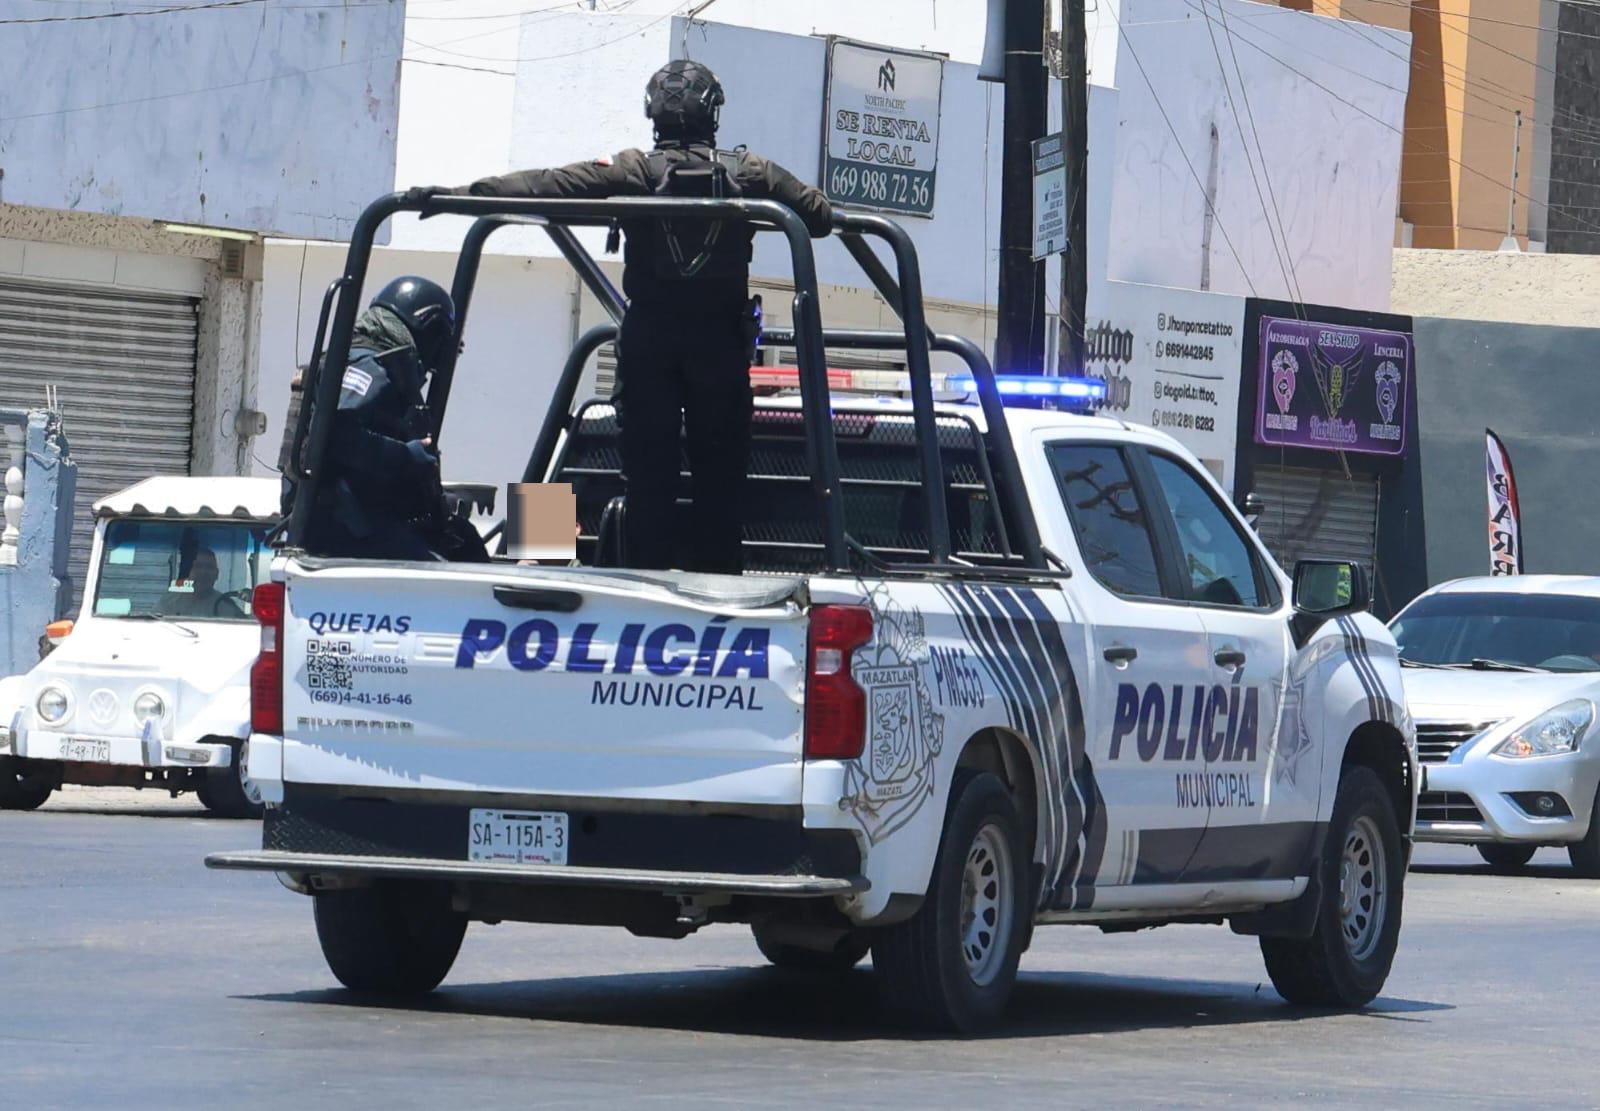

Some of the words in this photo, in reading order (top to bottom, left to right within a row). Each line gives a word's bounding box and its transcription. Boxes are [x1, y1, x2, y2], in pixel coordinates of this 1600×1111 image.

[836, 109, 860, 133] SE
[863, 113, 931, 143] RENTA
[847, 137, 916, 167] LOCAL
[831, 165, 858, 199] 669
[861, 169, 887, 201] 988
[891, 173, 908, 203] 72
[911, 176, 929, 207] 56
[1085, 320, 1134, 364] attoo
[309, 611, 412, 636] QUEJAS
[394, 656, 406, 664] DE
[454, 615, 770, 679] POLICÍA
[352, 665, 408, 675] AUTORIDAD
[310, 690, 412, 705] (669)4-41-16-46
[591, 680, 765, 711] MUNICIPAL
[1108, 667, 1259, 763] POLICÍA
[1176, 772, 1255, 809] MUNICIPAL
[473, 822, 564, 848] SA-115A-3
